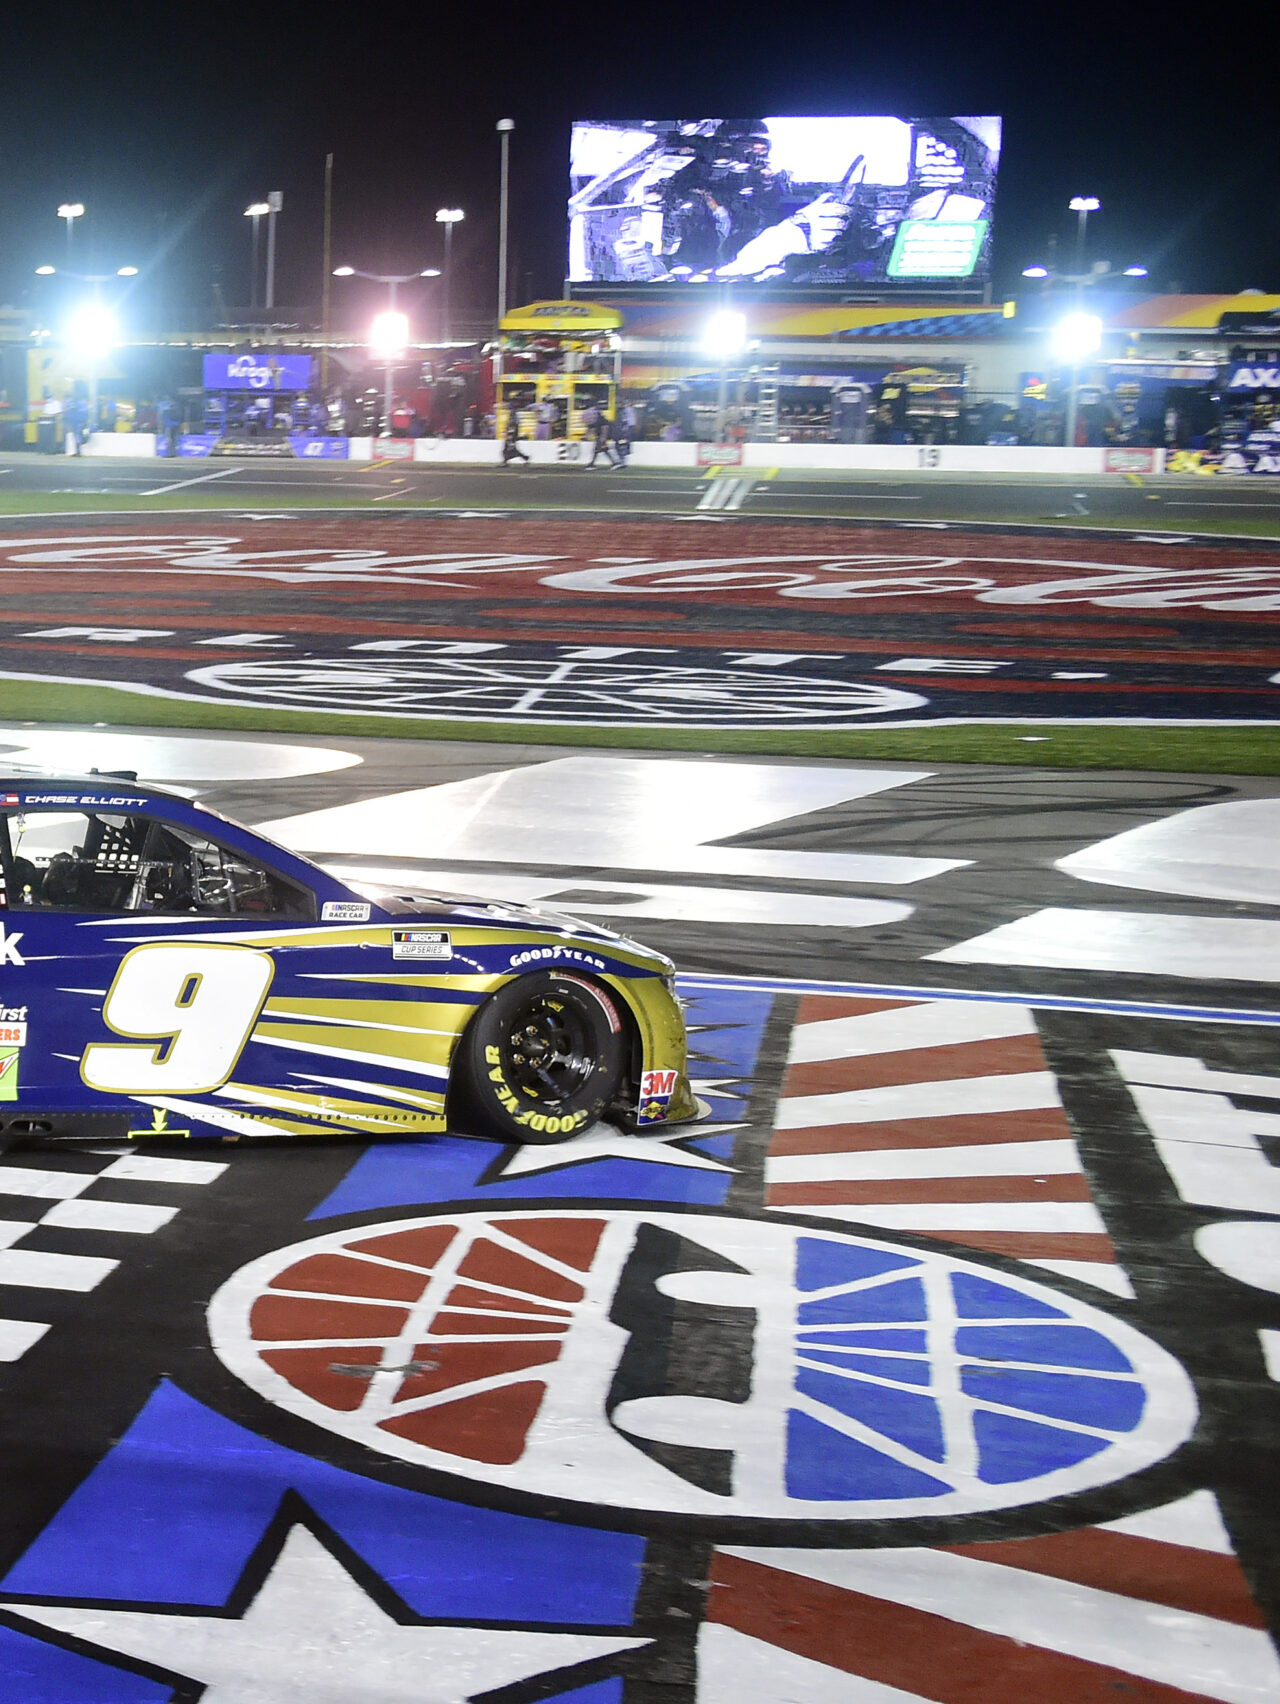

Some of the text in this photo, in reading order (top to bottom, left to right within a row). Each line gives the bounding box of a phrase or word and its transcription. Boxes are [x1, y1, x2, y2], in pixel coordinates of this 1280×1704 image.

[1229, 368, 1280, 387] AX
[24, 795, 149, 807] CHASE ELLIOTT
[339, 903, 365, 912] NASCAR
[401, 945, 443, 954] CUP SERIES
[509, 946, 605, 970] GOODYEAR
[80, 942, 276, 1095] 9
[642, 1071, 676, 1096] 3M
